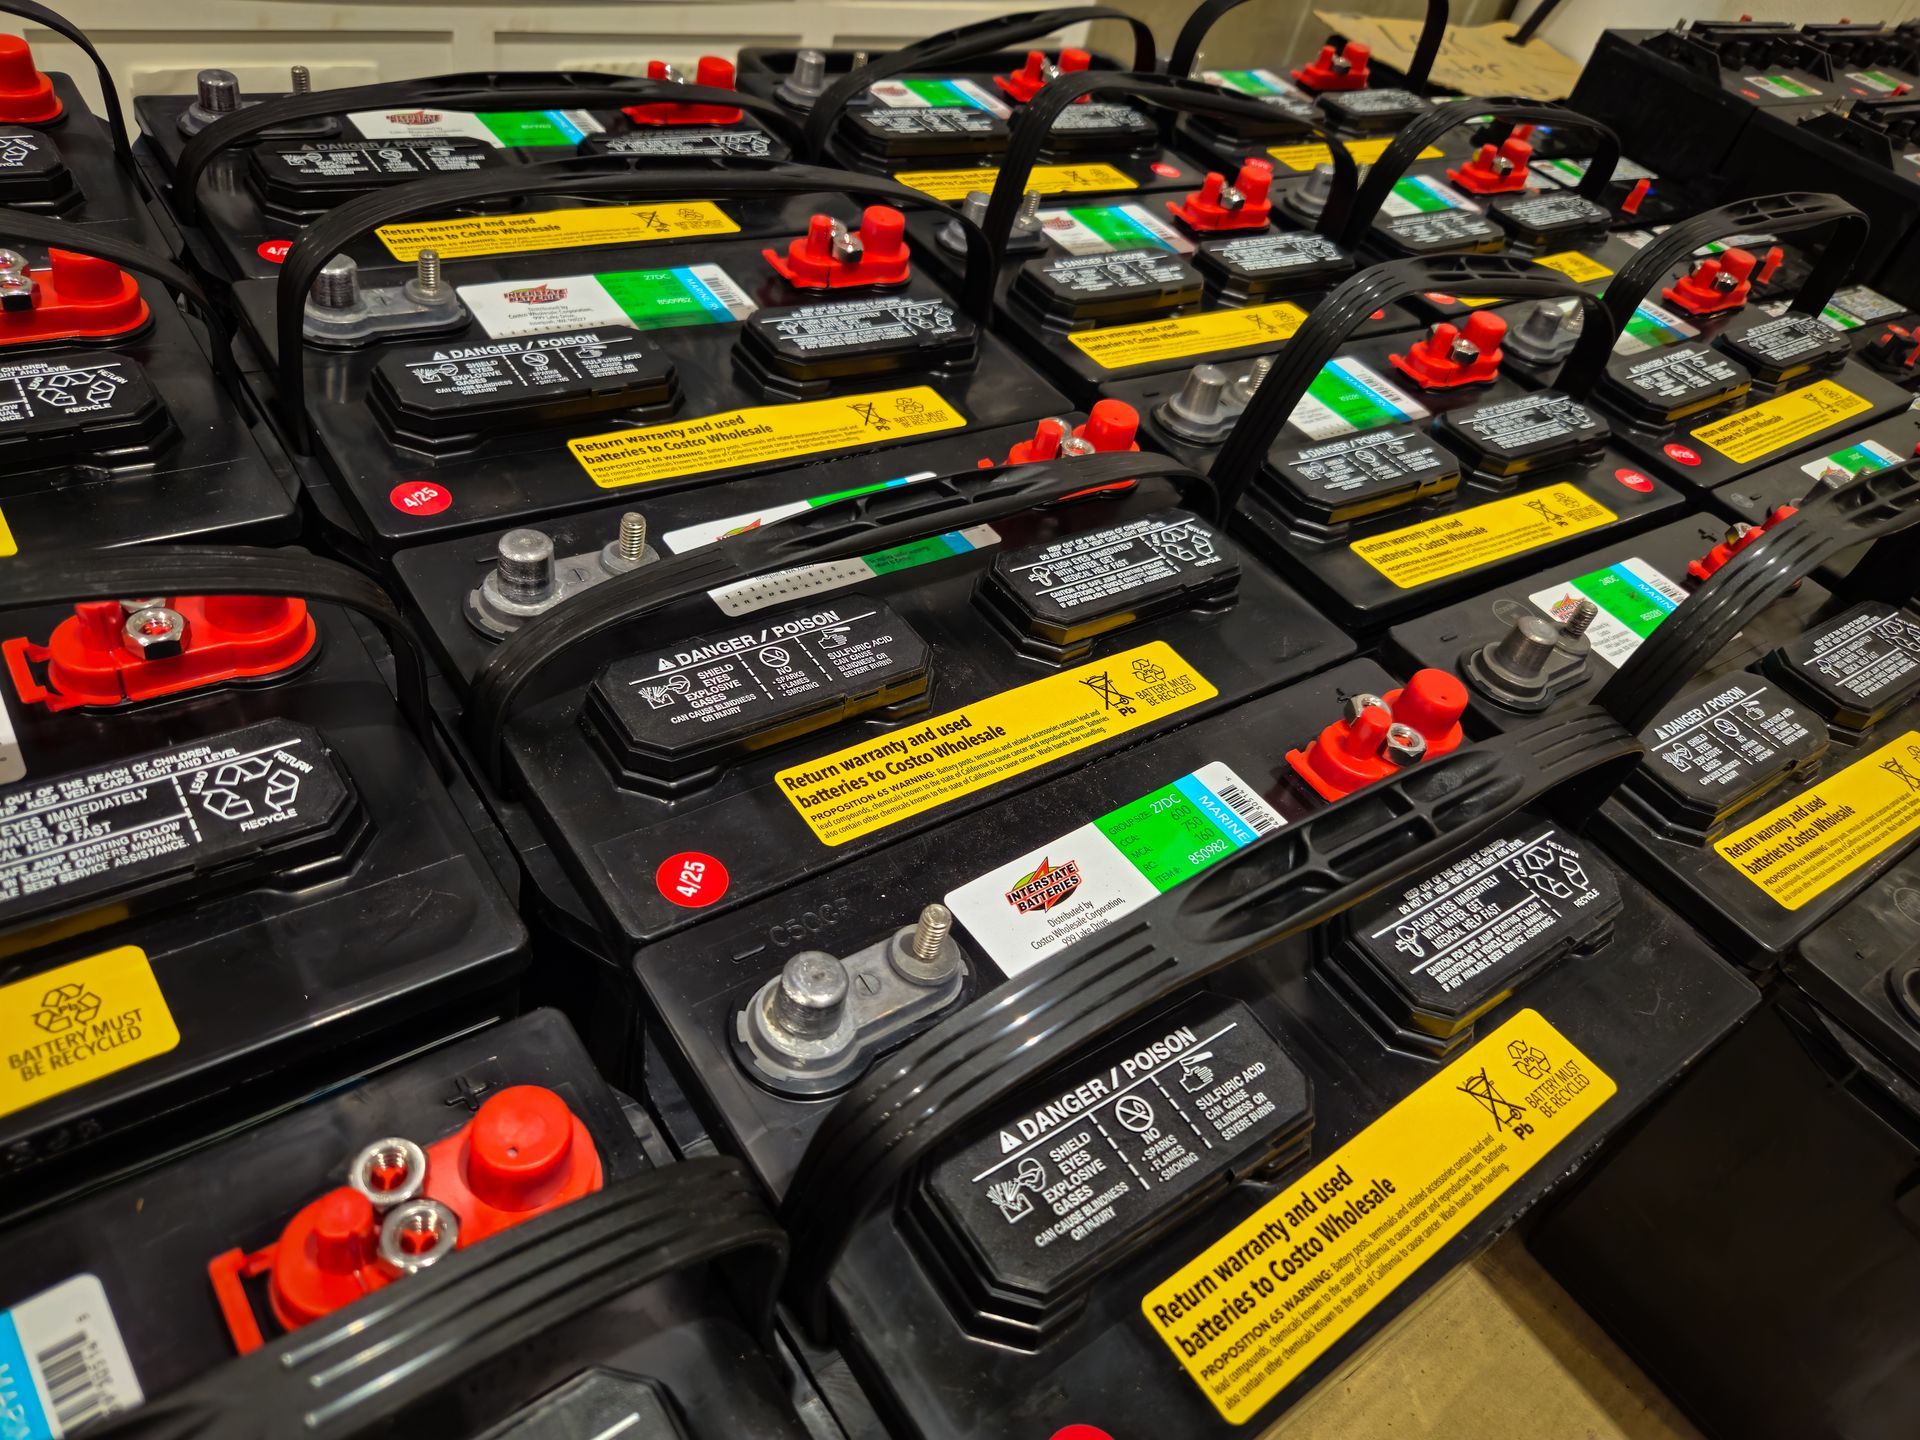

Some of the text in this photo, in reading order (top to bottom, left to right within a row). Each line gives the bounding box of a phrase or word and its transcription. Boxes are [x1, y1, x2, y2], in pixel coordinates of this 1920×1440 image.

[380, 228, 425, 236] Return
[426, 223, 481, 232] warranty
[508, 217, 536, 226] used
[386, 235, 444, 244] batteries
[460, 230, 499, 238] Costco
[499, 224, 561, 235] Wholesale
[449, 334, 600, 359] DANGER / POISON
[65, 403, 112, 414] RECYCLE
[574, 415, 745, 453] Return warranty and used
[583, 424, 773, 464] batteries to Costco Wholesale
[403, 487, 438, 507] 4/25
[1358, 519, 1464, 553] Return warranty and used
[1371, 526, 1488, 565] batteries to Costco Wholesale
[674, 610, 840, 666] DANGER / POISON
[827, 635, 893, 660] SULFURIC ACID
[775, 670, 805, 683] SPARKS
[776, 666, 792, 675] NO
[780, 677, 810, 690] FLAMES
[785, 681, 820, 696] SMOKING
[1135, 674, 1191, 700] BATTERY MUST
[1118, 706, 1137, 717] Pb
[1145, 681, 1197, 706] BE RECYCLED
[1662, 686, 1746, 735] DANGER / POISON
[782, 714, 972, 791] Return warranty and used
[795, 726, 1006, 809] batteries to Costco Wholesale
[810, 709, 1101, 822] PROPOSITION 65 WARNING: Battery posts, terminals and related accessories contain lead and
[0, 788, 147, 837] EYES IMMEDIATELY
[240, 808, 298, 832] RECYCLE
[1149, 793, 1181, 814] 27DC
[1170, 805, 1191, 821] 600
[27, 821, 111, 854] HELP FAST
[1181, 816, 1203, 832] 750
[1194, 828, 1215, 842] 160
[1723, 795, 1827, 859] Return warranty and used
[1741, 805, 1856, 875] batteries to Costco Wholesale
[1188, 839, 1228, 864] 850982
[676, 861, 705, 897] 4/25
[1007, 864, 1075, 904] INTERSTATE
[1017, 875, 1079, 912] BATTERIES
[1047, 900, 1094, 928] Distributed by
[1411, 874, 1500, 931] FLUSH EYES IMMEDIATELY
[1030, 897, 1126, 950] Costco Wholesale Corporation,
[1431, 903, 1501, 950] MEDICAL HELP FAST
[8, 1008, 142, 1071] BATTERY MUST
[18, 1025, 142, 1082] BE RECYCLED
[1017, 1026, 1197, 1140] DANGER / POISON
[1196, 1062, 1266, 1110] SULFURIC ACID
[1524, 1059, 1581, 1109] BATTERY MUST
[1539, 1072, 1590, 1119] BE RECYCLED
[1141, 1127, 1161, 1144] NO
[1144, 1089, 1249, 1159] SPARKS CAN CAUSE
[1152, 1092, 1268, 1170] FLAMES BLINDNESS OR
[1161, 1101, 1276, 1180] SMOKING SEVERE BURNS
[1512, 1123, 1534, 1141] Pb
[1049, 1132, 1091, 1162] SHIELD
[1058, 1150, 1091, 1175] EYES
[1042, 1158, 1107, 1204] EXPLOSIVE
[1035, 1181, 1129, 1247] CAN CAUSE BLINDNESS
[1053, 1185, 1094, 1215] GASES
[1071, 1205, 1116, 1240] OR INJURY
[1152, 1164, 1353, 1328] Return warranty and used
[1174, 1179, 1396, 1358] batteries to Costco Wholesale
